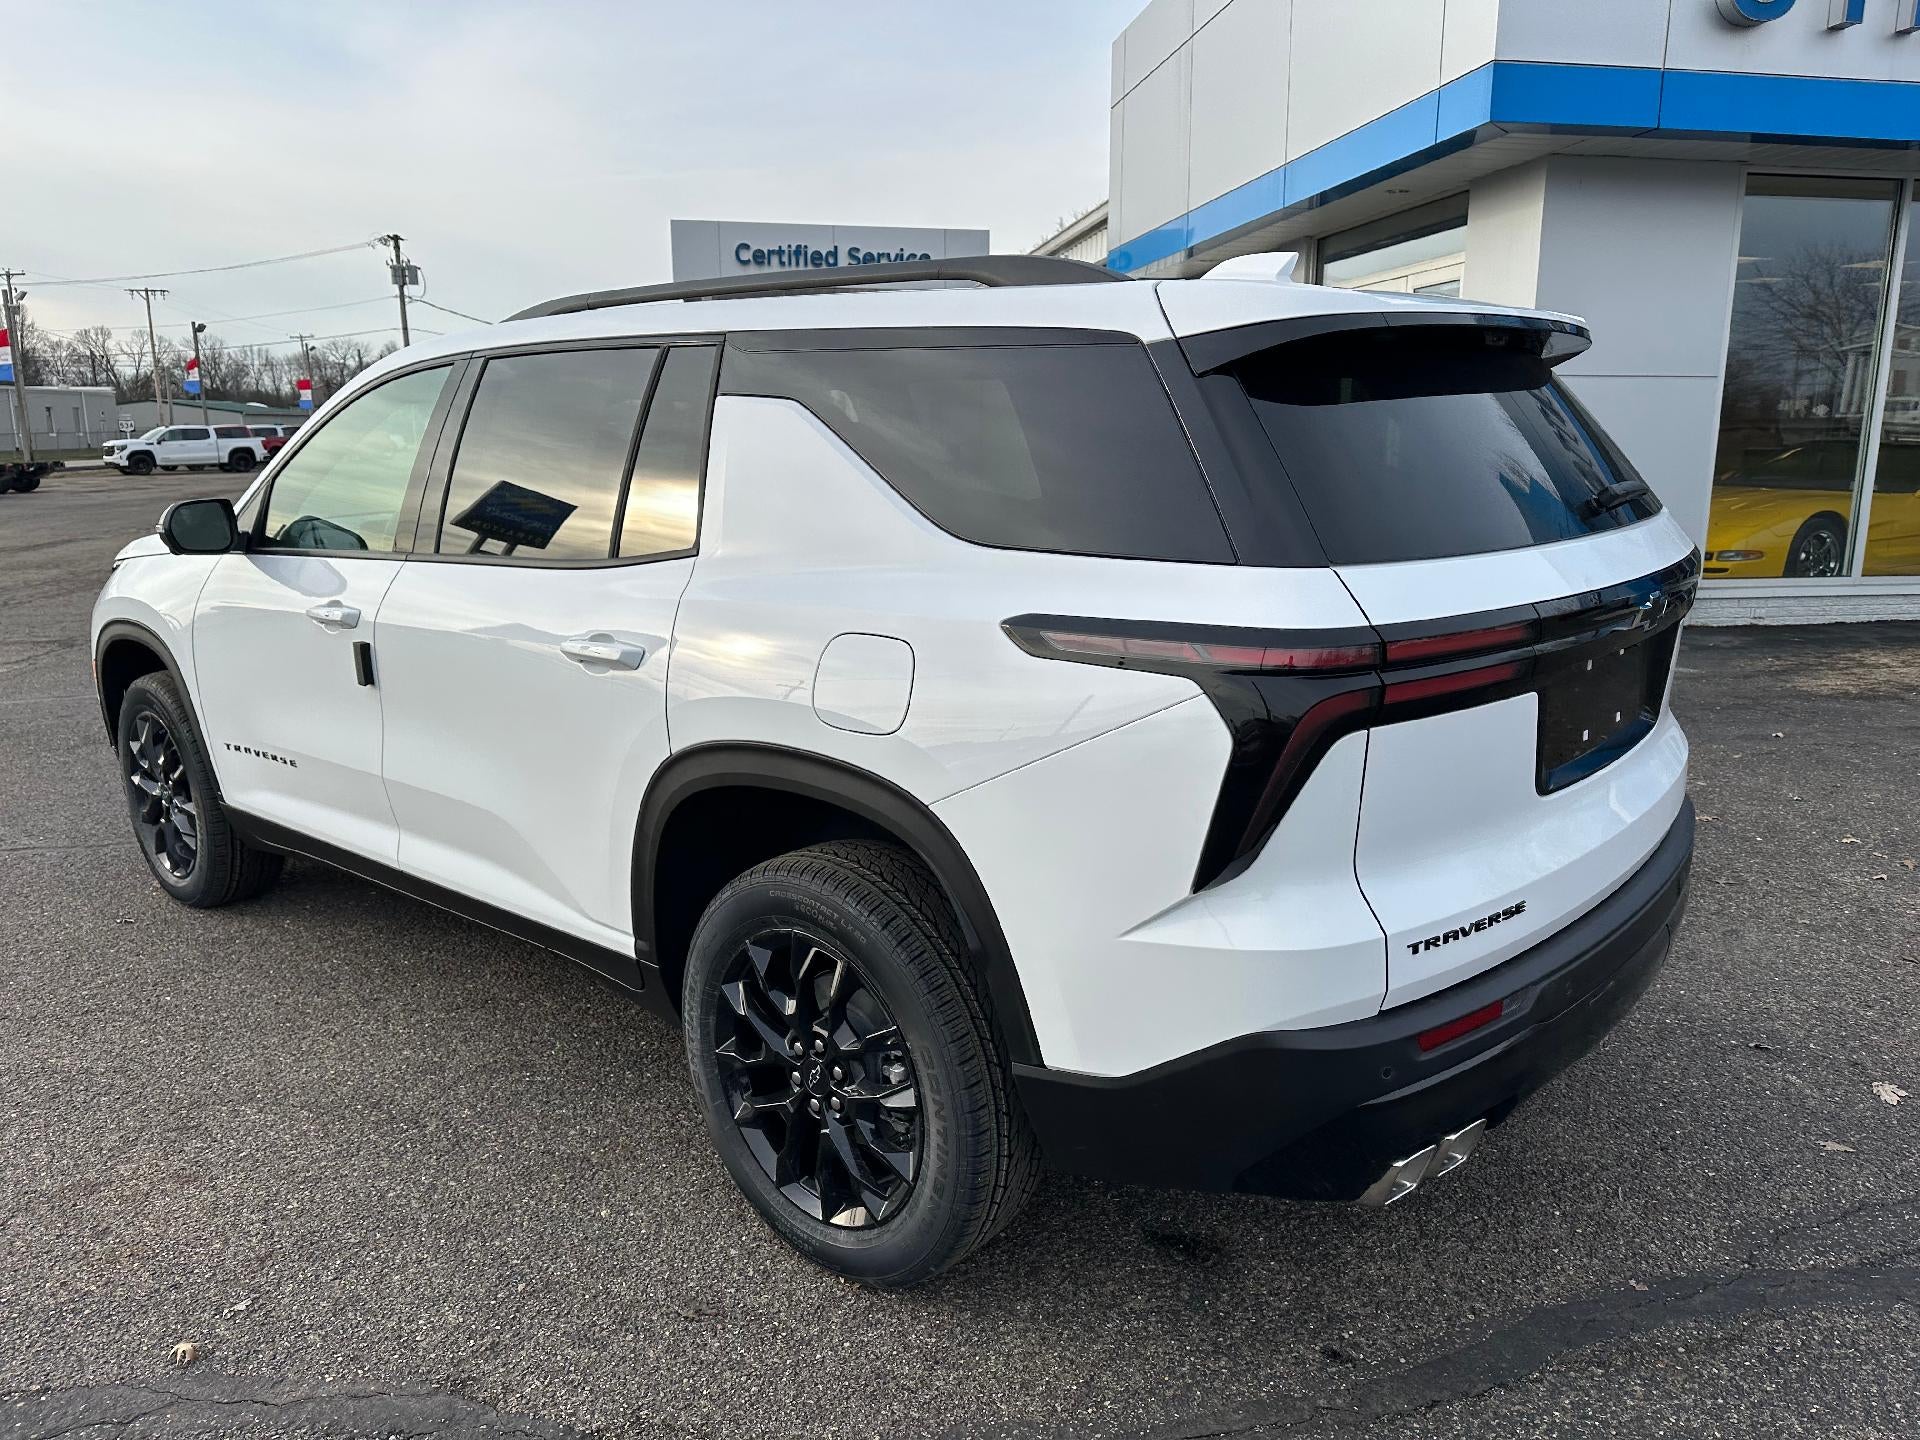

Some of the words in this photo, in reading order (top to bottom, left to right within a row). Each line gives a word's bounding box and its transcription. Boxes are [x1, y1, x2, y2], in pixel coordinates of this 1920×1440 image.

[735, 242, 838, 267] Certified
[224, 742, 298, 768] TRAVERSE
[1407, 900, 1527, 955] TRAVERSE
